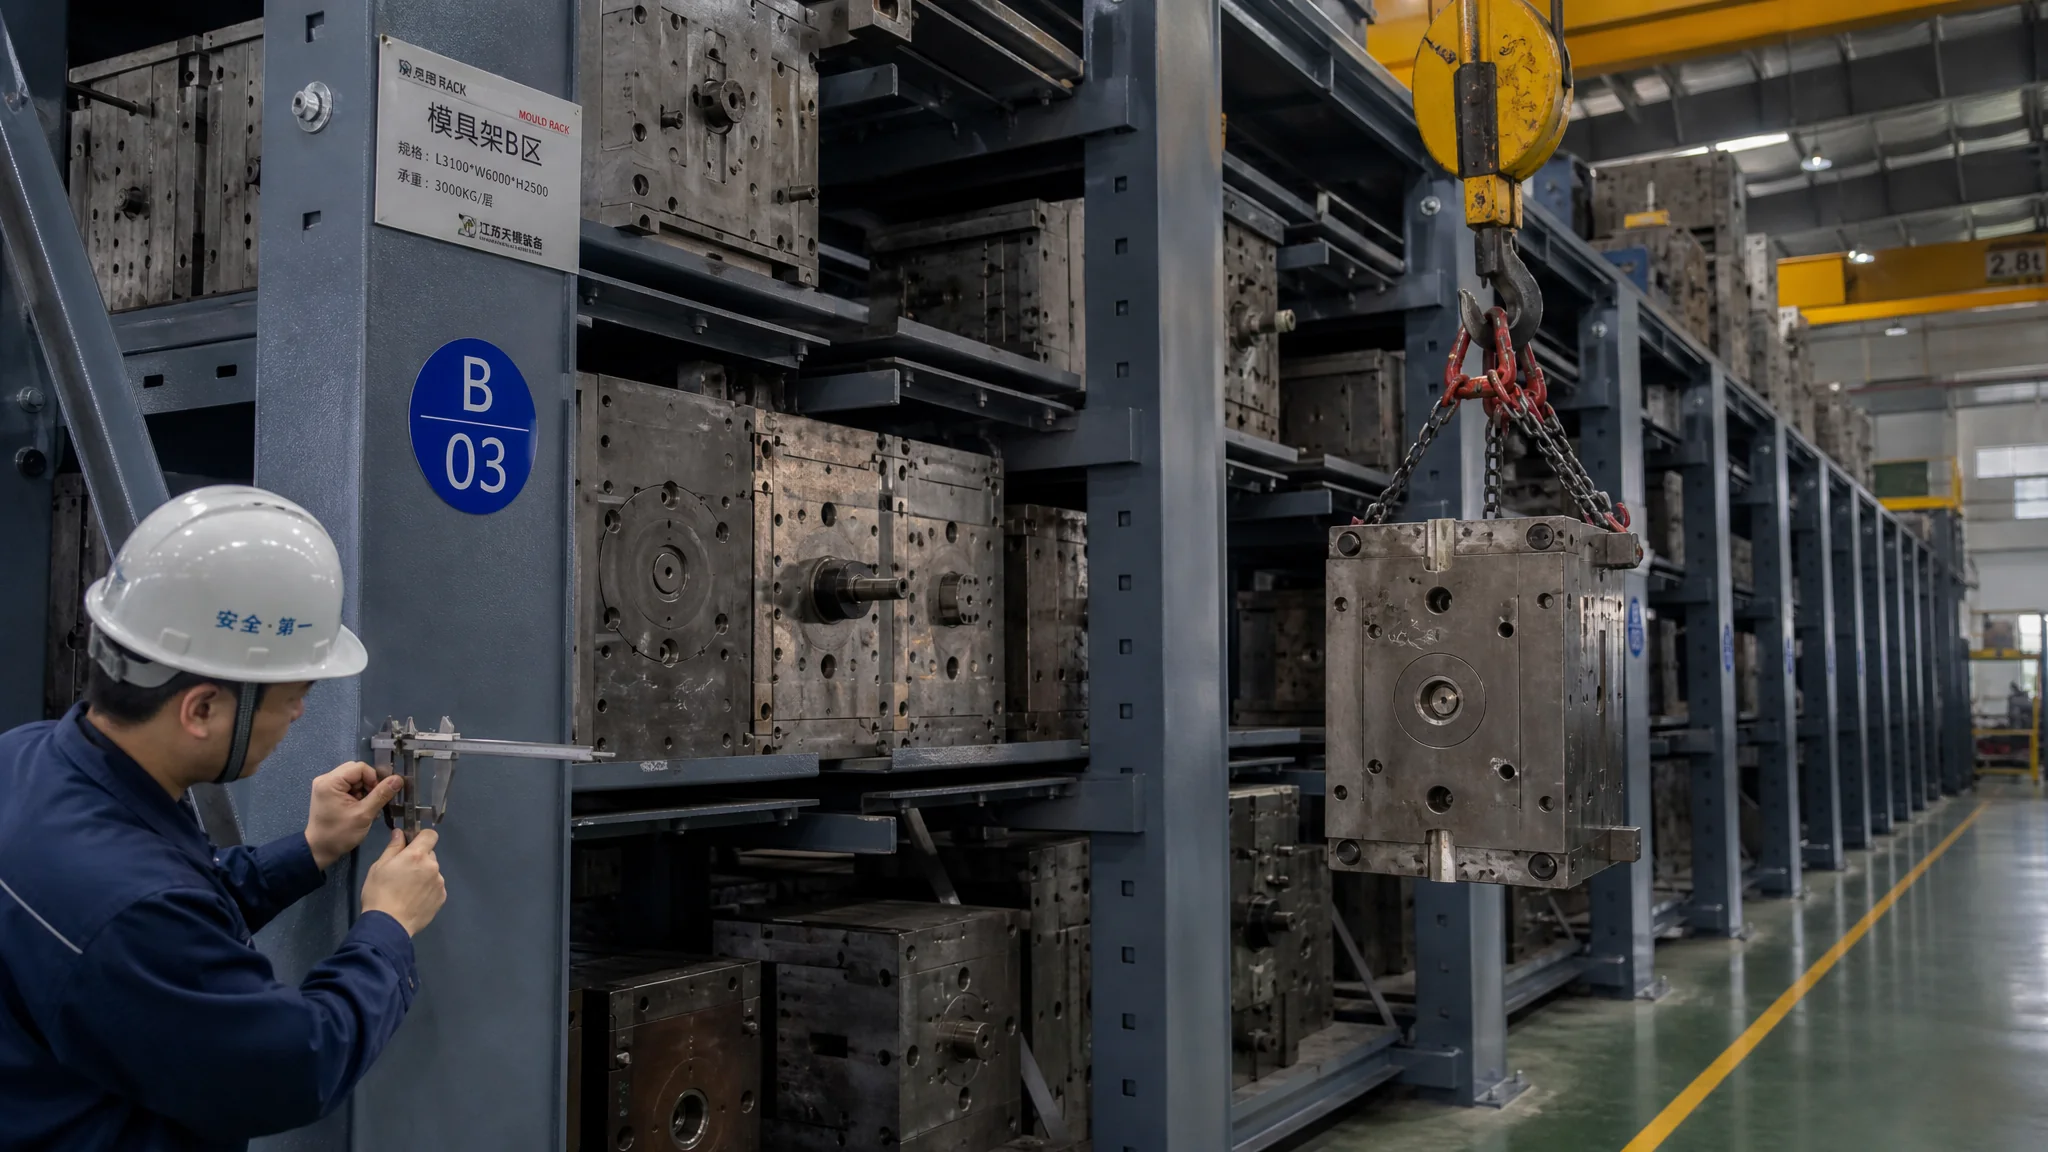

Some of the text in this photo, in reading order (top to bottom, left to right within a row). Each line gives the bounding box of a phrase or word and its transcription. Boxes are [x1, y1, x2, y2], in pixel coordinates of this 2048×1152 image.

[427, 101, 543, 167] 模具架B区
[518, 109, 570, 135] MOULD RACK
[463, 355, 493, 413] B
[446, 432, 507, 494] 03
